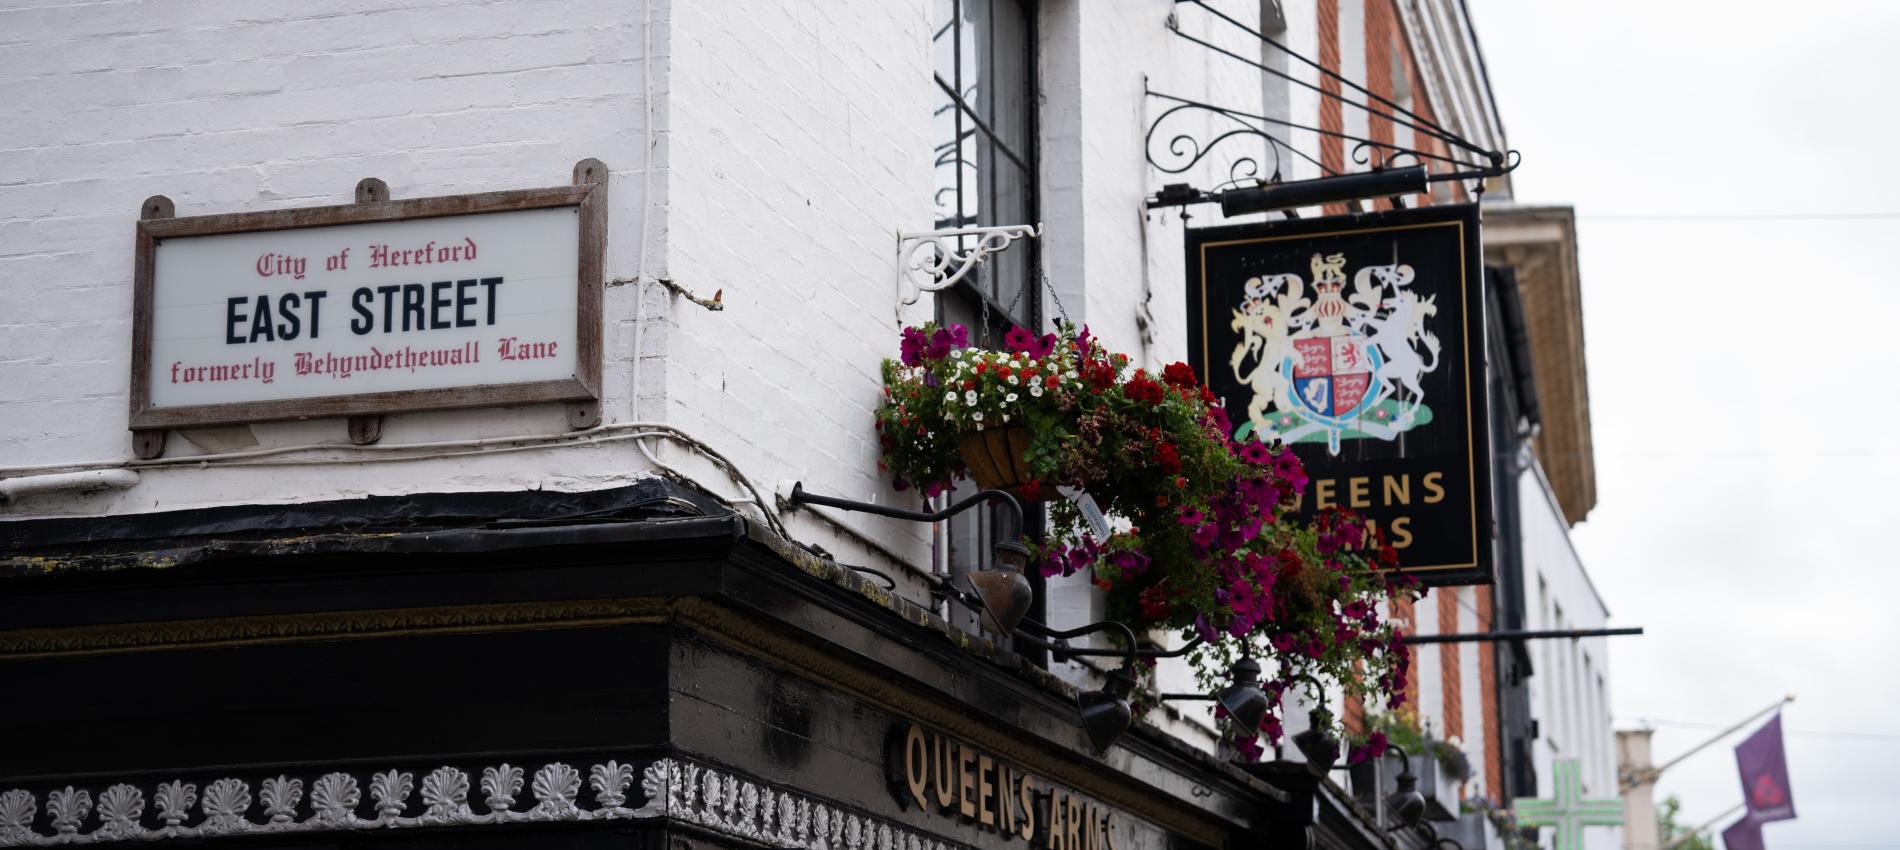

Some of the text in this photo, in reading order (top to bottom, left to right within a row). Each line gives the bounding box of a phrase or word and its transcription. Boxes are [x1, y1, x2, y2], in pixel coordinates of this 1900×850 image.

[257, 238, 477, 279] City of Hereford
[226, 276, 504, 344] EAST STREET
[171, 337, 558, 384] formerly Behyndethewall Lane
[906, 723, 1119, 850] QUEENS ARMS
